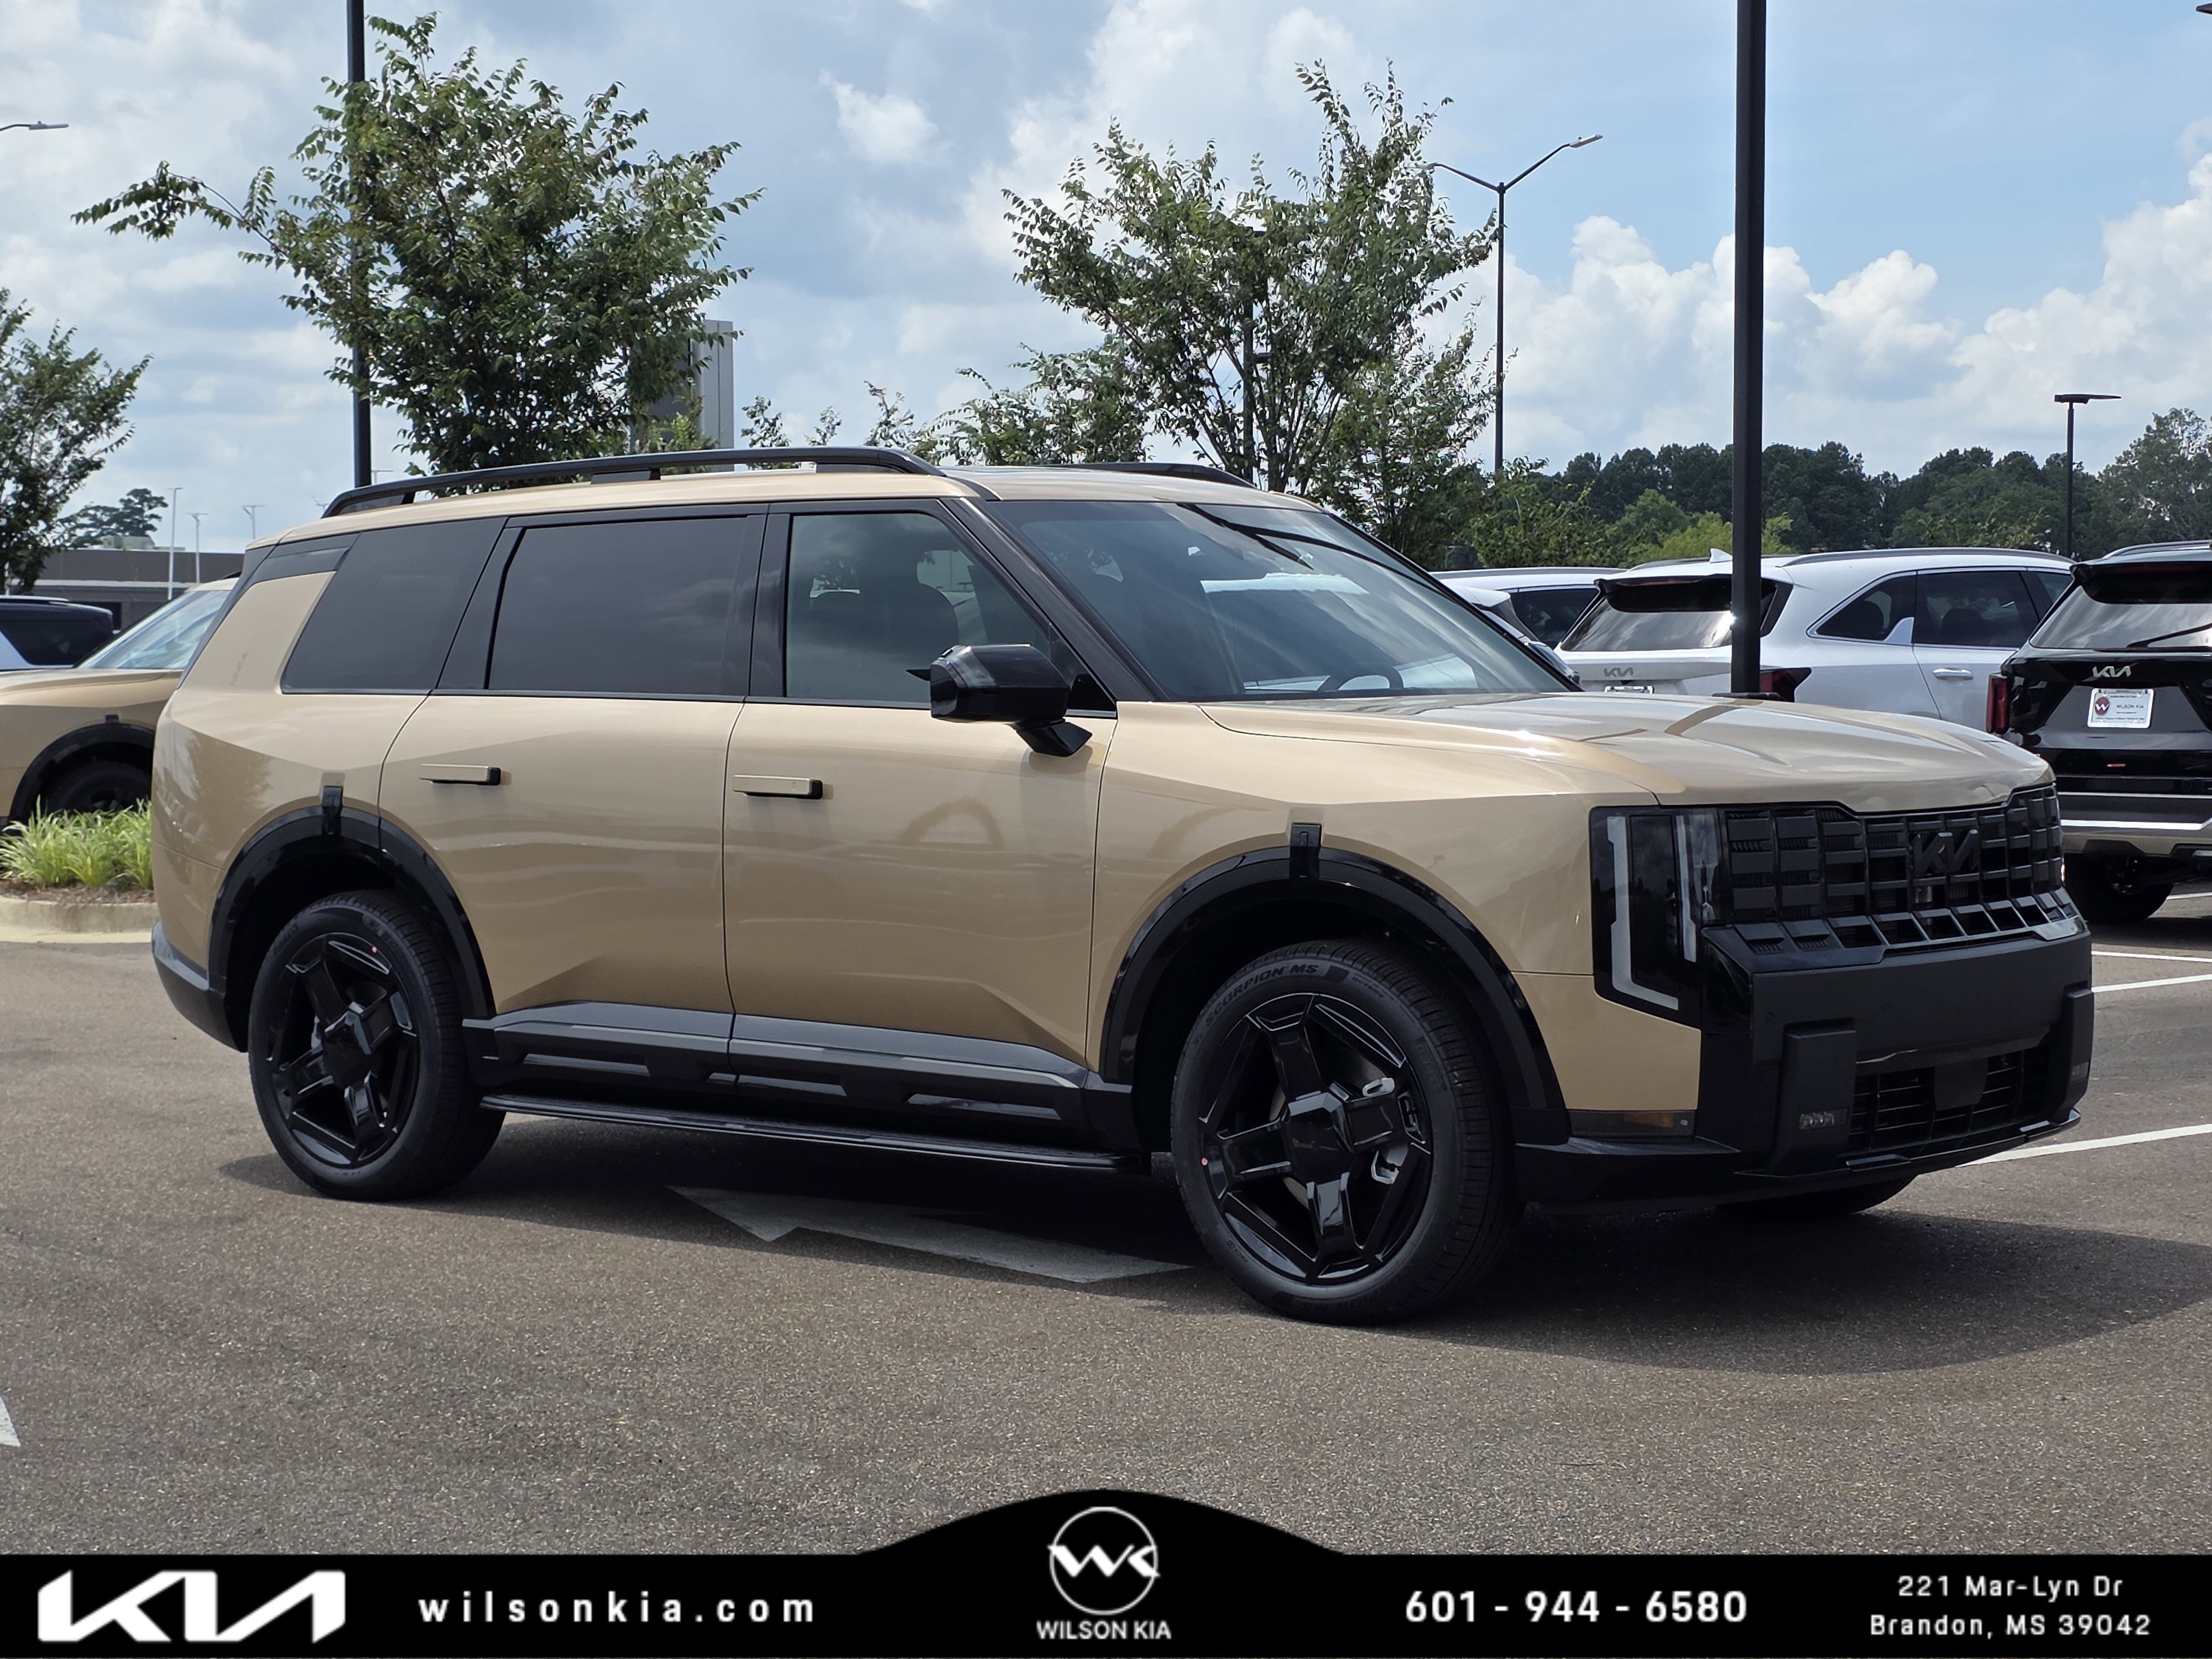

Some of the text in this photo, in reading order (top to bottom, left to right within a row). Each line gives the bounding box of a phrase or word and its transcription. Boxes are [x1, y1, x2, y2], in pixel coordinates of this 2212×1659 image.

[1603, 666, 1634, 677] KIA
[2092, 665, 2132, 677] KIA
[1911, 828, 1980, 876] KIA
[1205, 963, 1319, 1027] SCORPION MS
